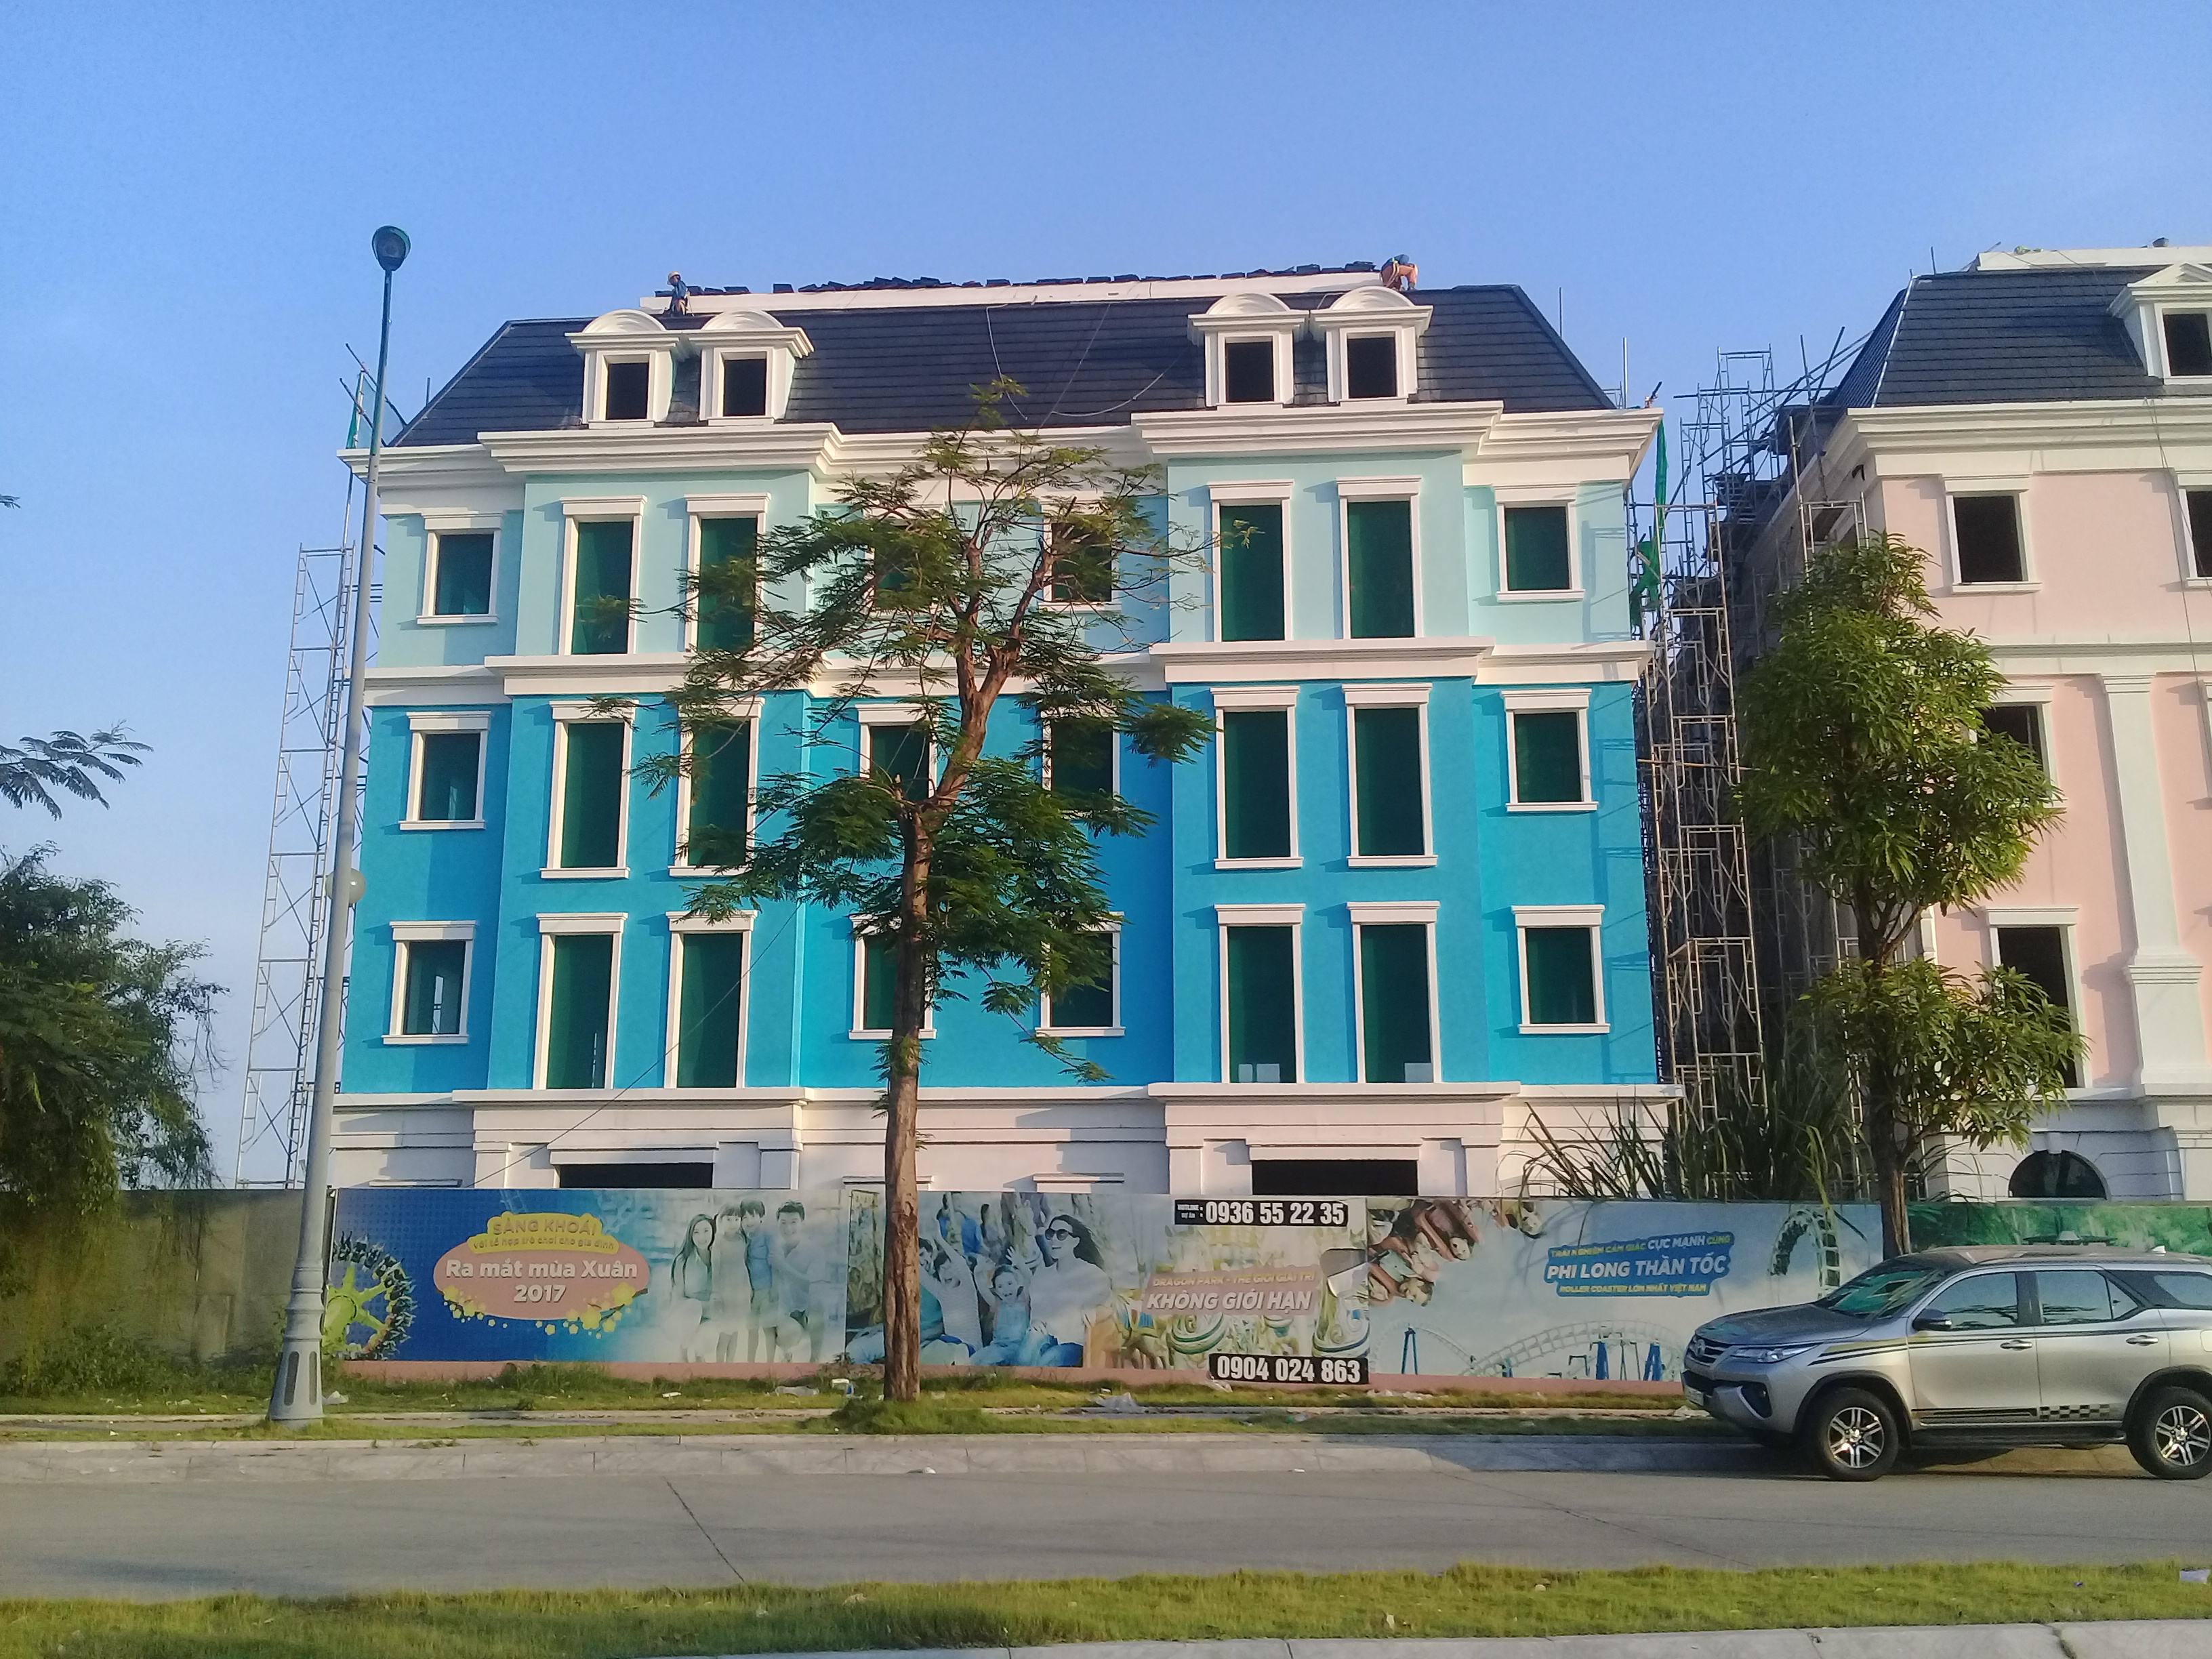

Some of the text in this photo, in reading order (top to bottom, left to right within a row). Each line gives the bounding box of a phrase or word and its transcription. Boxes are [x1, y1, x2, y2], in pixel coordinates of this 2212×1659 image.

[1205, 1202, 1254, 1223] 0936
[1259, 1202, 1284, 1224] 55
[1290, 1202, 1314, 1224] 22
[1319, 1202, 1345, 1225] 35
[544, 1218, 596, 1236] KHOÁI
[559, 1235, 575, 1246] cho
[1647, 1237, 1671, 1251] CỰC
[1672, 1235, 1706, 1248] MẠNH
[445, 1257, 638, 1279] Ra mắt mùa Xuân
[1547, 1264, 1578, 1279] PHI
[1580, 1261, 1631, 1279] LONG
[1689, 1251, 1727, 1275] TỐC
[513, 1284, 567, 1303] 2017
[1147, 1288, 1313, 1313] KHÔNG GIỚI HẠN
[1216, 1356, 1361, 1383] 0904 024 863
